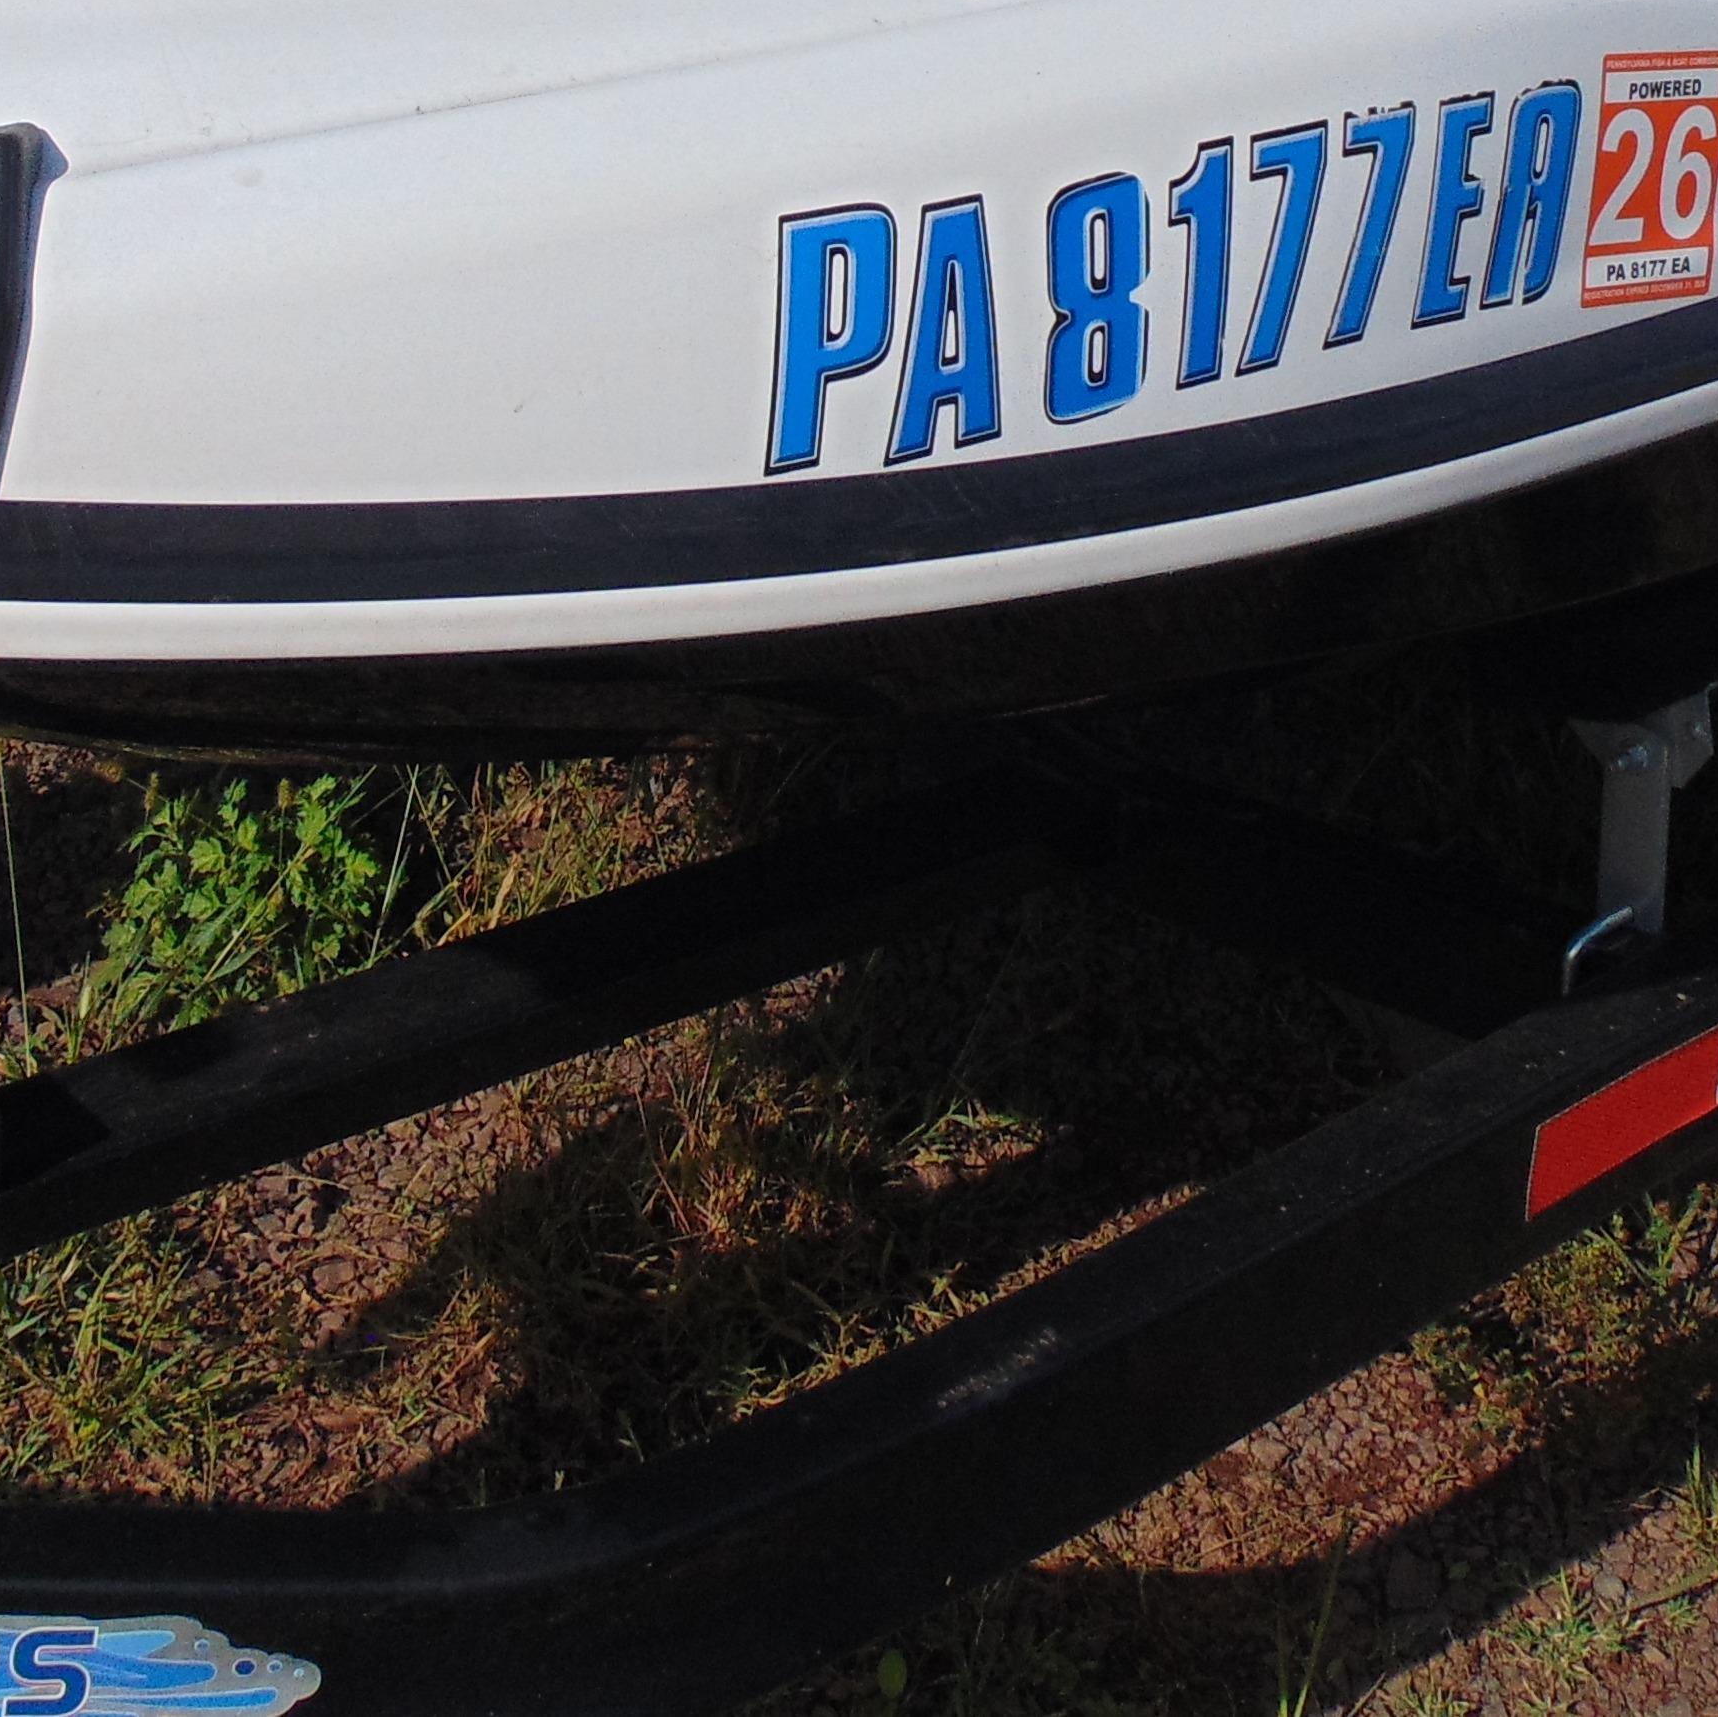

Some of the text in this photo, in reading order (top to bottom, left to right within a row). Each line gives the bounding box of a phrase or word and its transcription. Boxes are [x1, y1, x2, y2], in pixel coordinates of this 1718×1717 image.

[1628, 78, 1702, 100] POWERED
[1588, 104, 1718, 247] 26
[1606, 256, 1691, 282] PA 8177 EA
[762, 193, 1002, 476] PA
